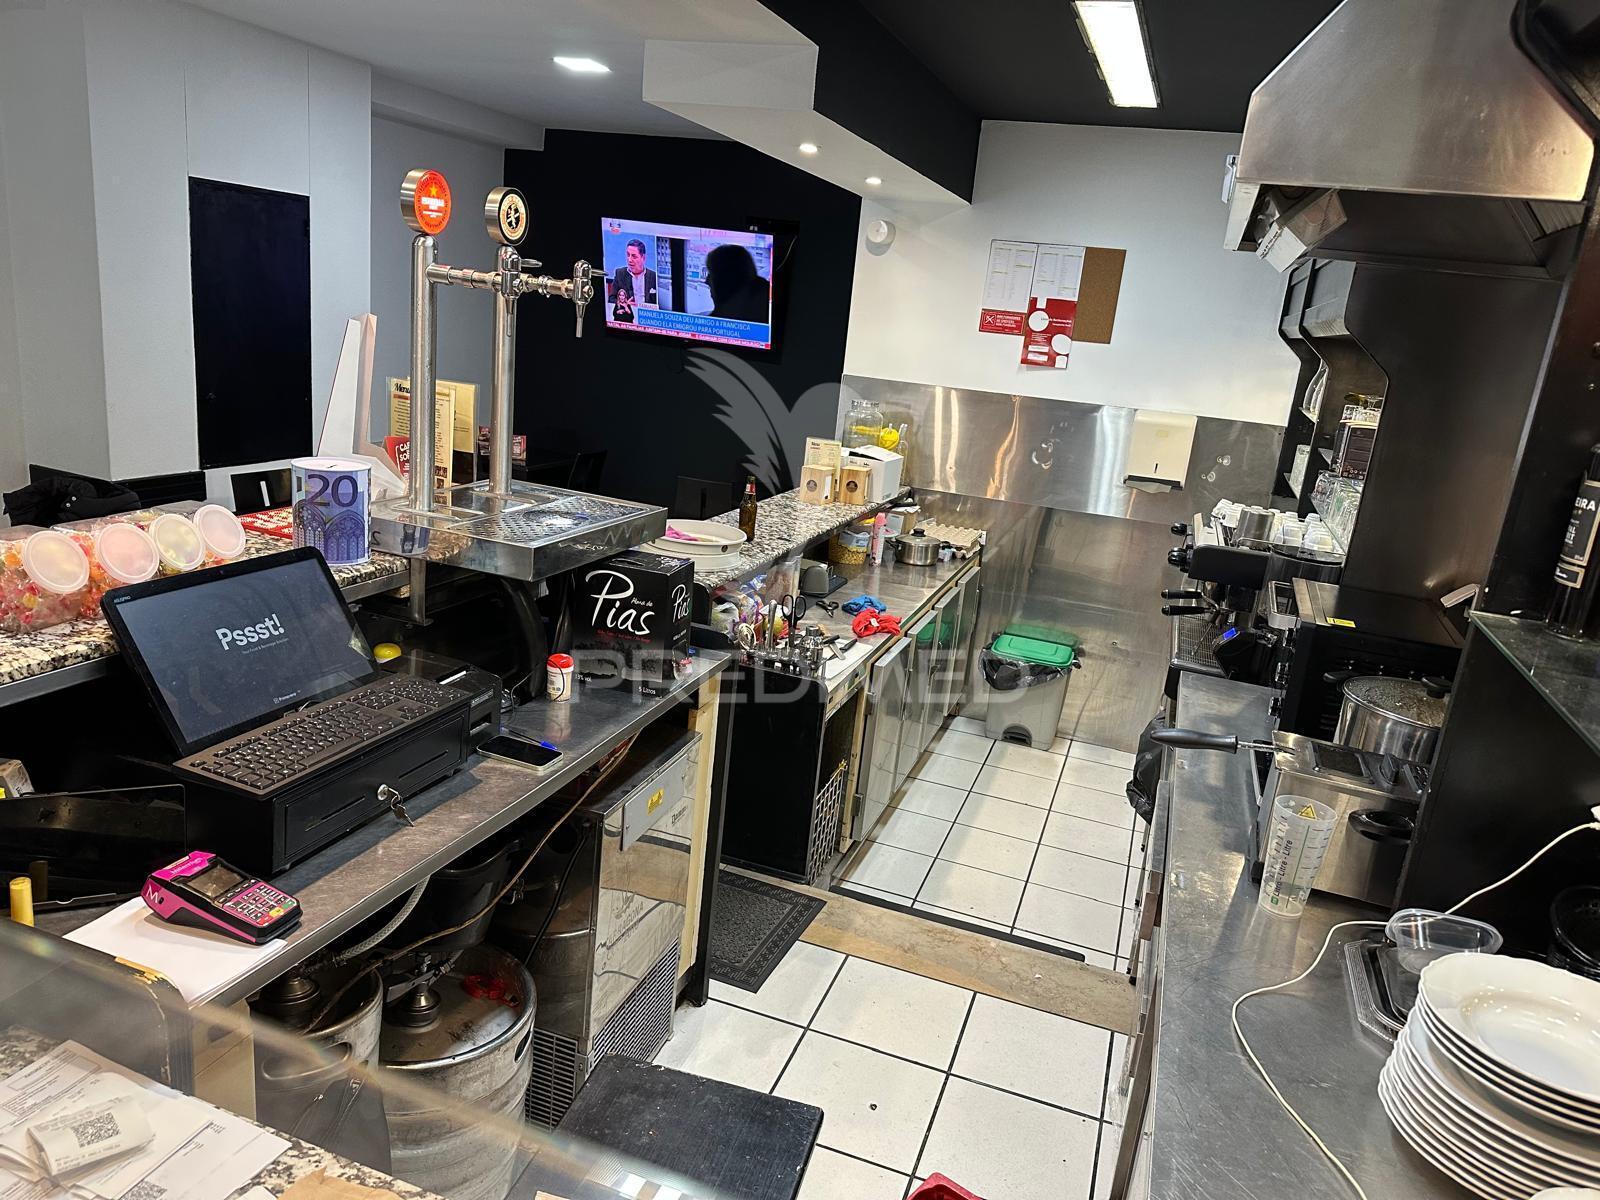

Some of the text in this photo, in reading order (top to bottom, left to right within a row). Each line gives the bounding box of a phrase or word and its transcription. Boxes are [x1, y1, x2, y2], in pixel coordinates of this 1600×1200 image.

[639, 310, 663, 319] MANUELA
[664, 313, 682, 321] SOUZA
[682, 315, 693, 323] DEU
[694, 317, 714, 326] ABRIGO
[719, 320, 750, 330] FRANCISCA
[639, 317, 662, 326] QUANDO
[662, 320, 672, 328] ELA
[698, 325, 711, 333] PARA
[712, 327, 740, 337] PORTUGAL
[308, 474, 359, 508] 20
[585, 570, 655, 635] Pias
[215, 613, 285, 650] Pssst!
